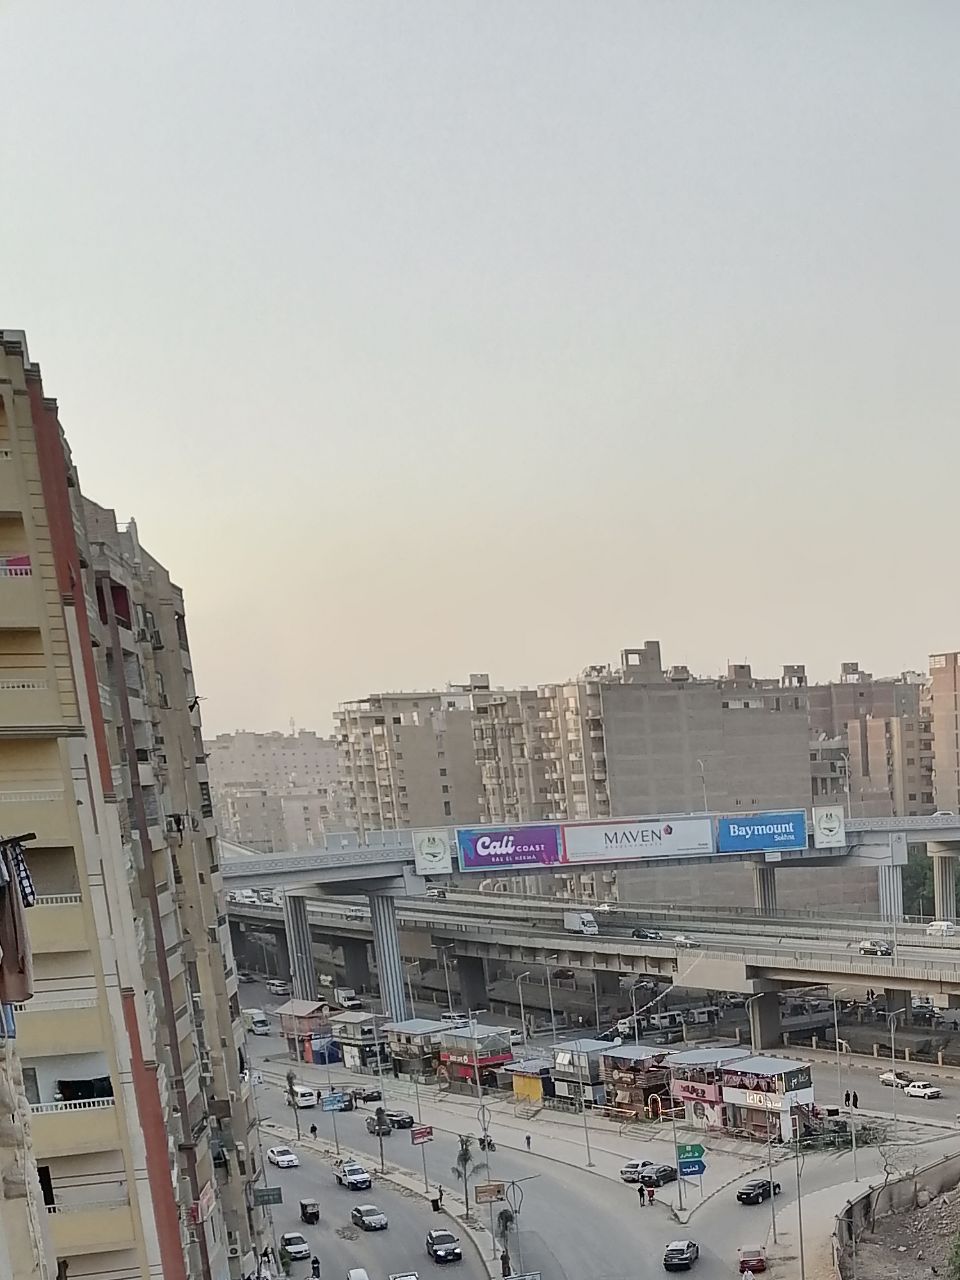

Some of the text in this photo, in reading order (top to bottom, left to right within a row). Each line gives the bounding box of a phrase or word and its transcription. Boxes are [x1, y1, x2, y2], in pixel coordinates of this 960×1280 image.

[604, 829, 662, 844] MAVEN
[729, 822, 794, 838] Baymount
[476, 836, 544, 856] Cali COAST
